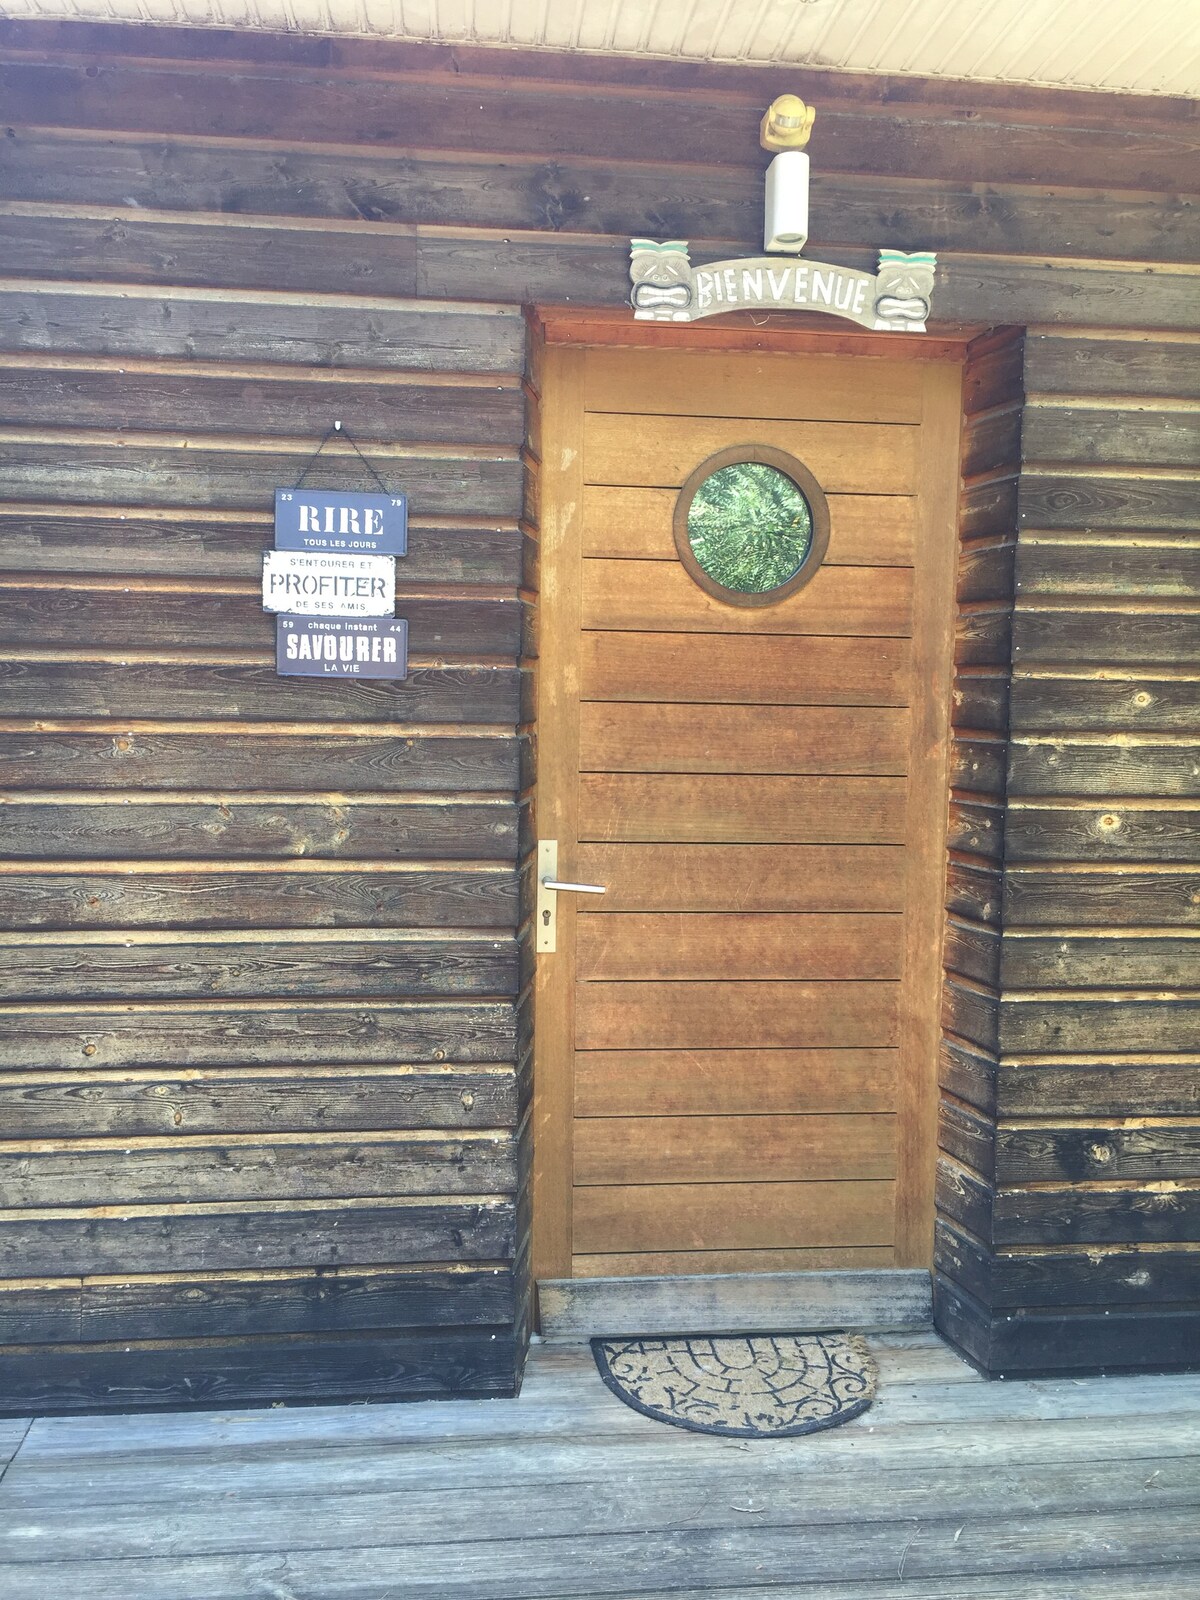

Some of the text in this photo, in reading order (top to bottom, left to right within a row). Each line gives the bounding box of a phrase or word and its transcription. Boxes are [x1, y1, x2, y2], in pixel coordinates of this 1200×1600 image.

[696, 267, 869, 314] BIENVENUE
[281, 493, 402, 507] 23 79
[298, 505, 384, 535] RIRE
[304, 538, 377, 549] TOUS LES JOURS
[290, 558, 373, 569] S'ENTOURER ET
[270, 573, 386, 598] PROFITER
[296, 601, 366, 610] DE SES AMIS
[282, 621, 294, 629] 59
[307, 622, 341, 632] chaque
[345, 622, 378, 632] instant
[286, 633, 397, 663] SAVOURER
[324, 663, 360, 673] LA VIE
